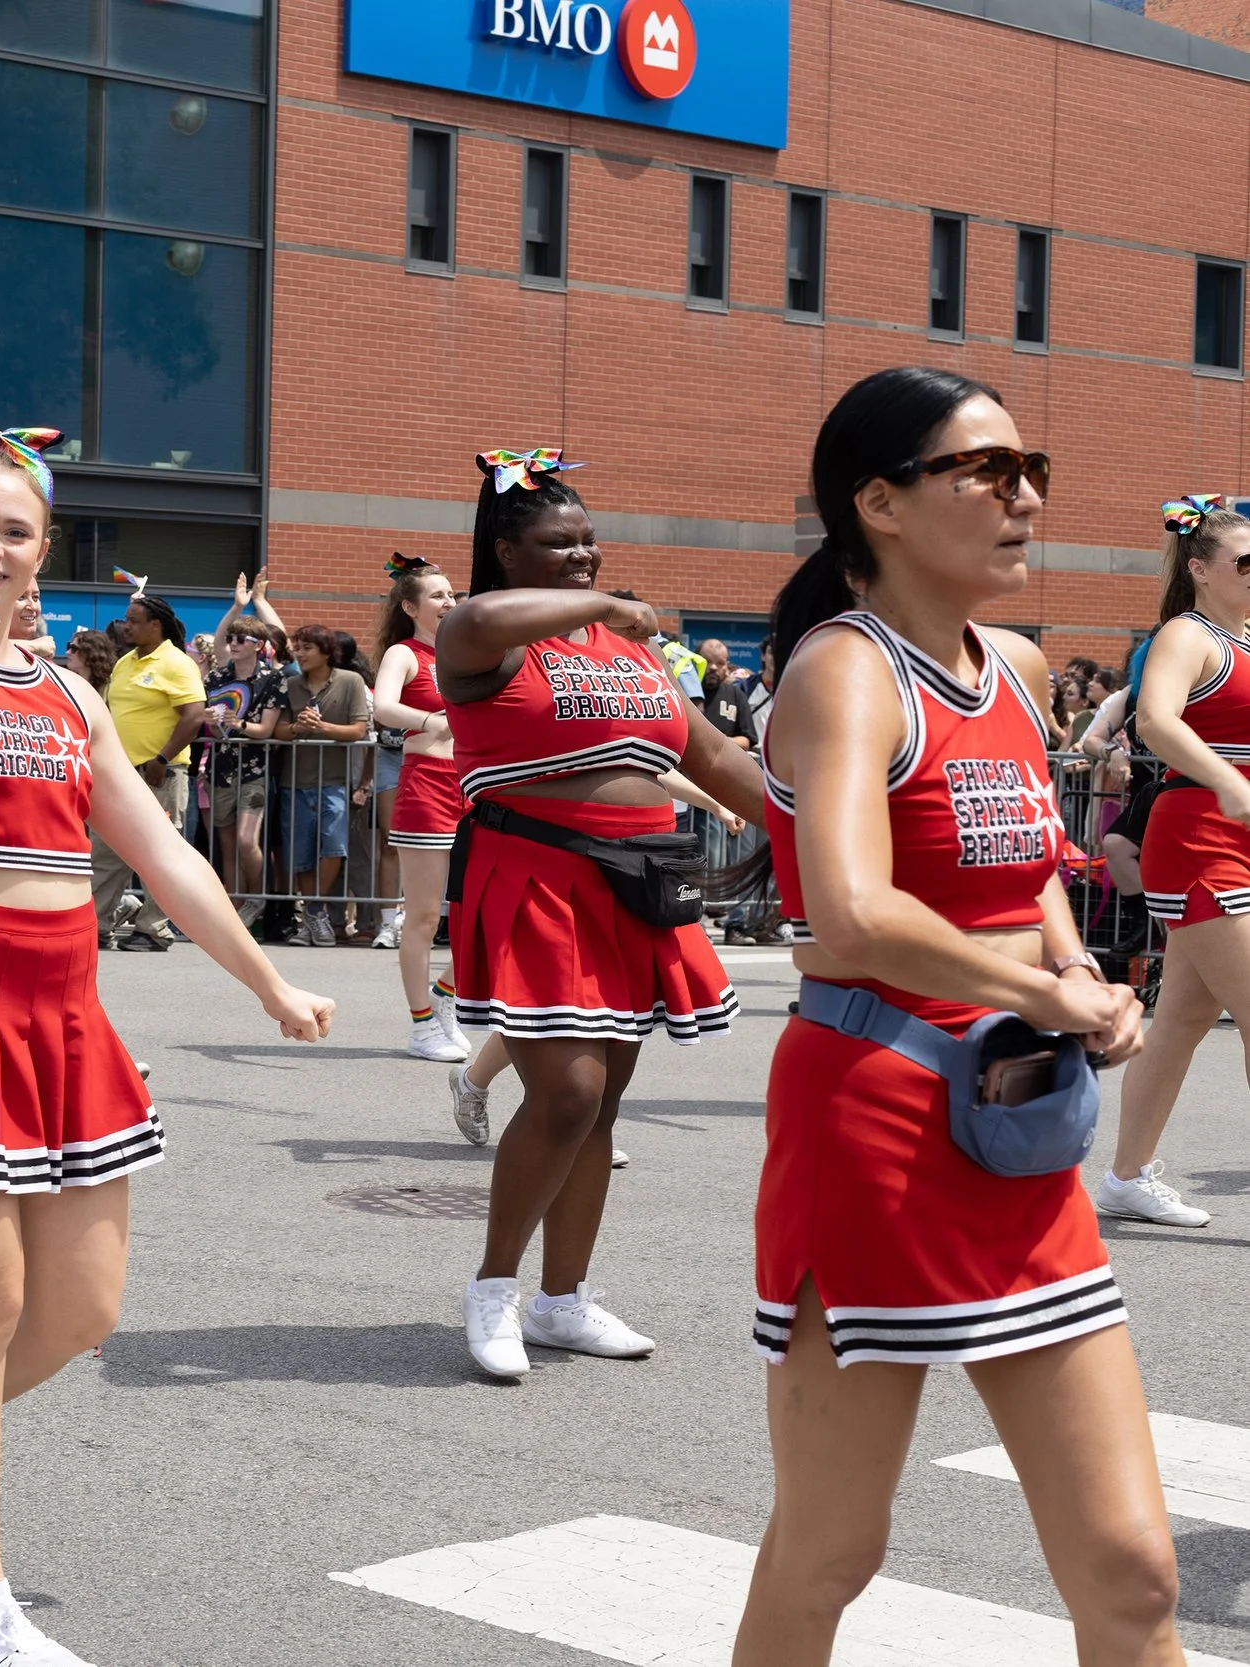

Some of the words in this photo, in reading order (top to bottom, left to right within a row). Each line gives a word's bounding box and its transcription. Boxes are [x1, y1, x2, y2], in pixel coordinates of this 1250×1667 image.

[490, 0, 612, 56] BMO
[549, 672, 645, 694] SPIRIT
[553, 694, 672, 720] BRIGADE
[942, 759, 1026, 795] CHICAGO
[951, 794, 1026, 829] SPIRIT
[957, 828, 1046, 867] BRIGADE
